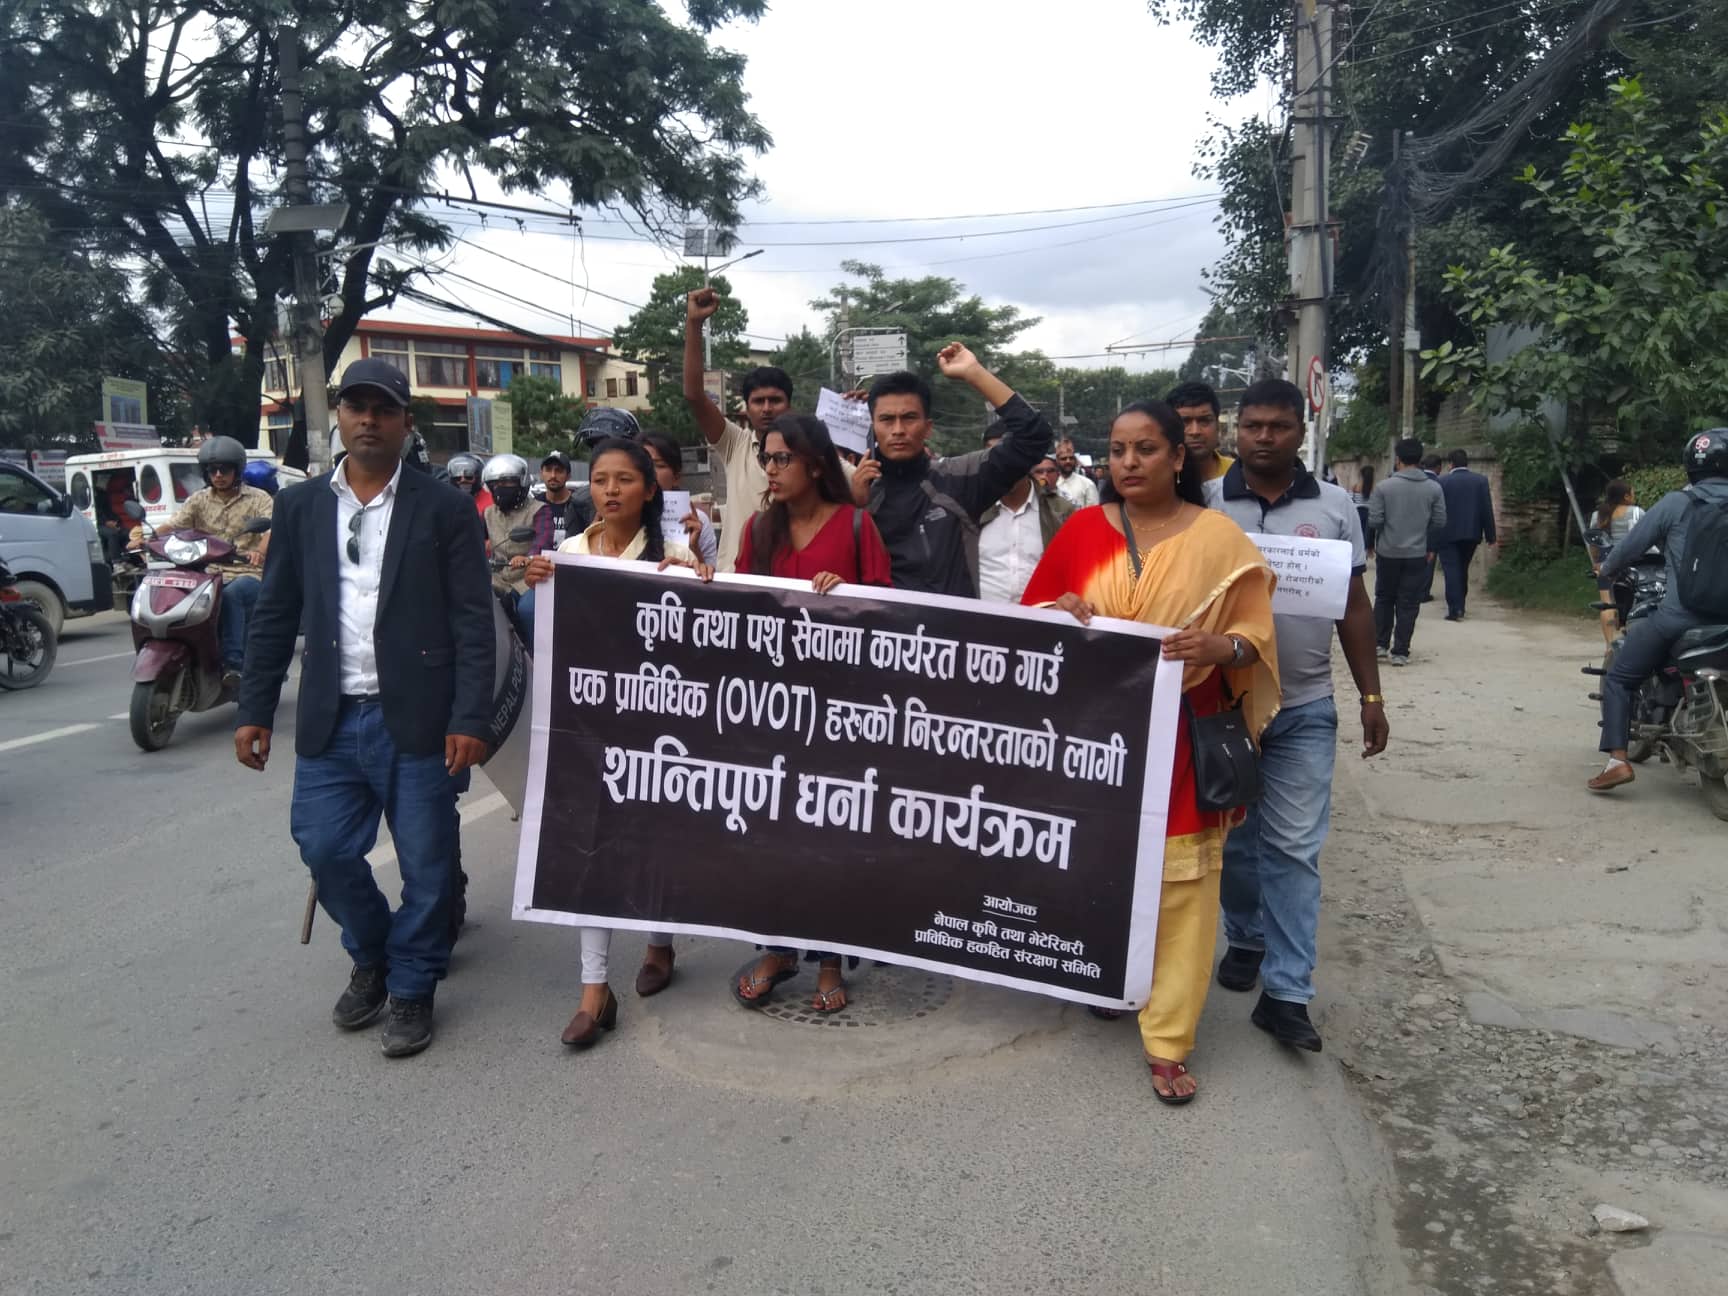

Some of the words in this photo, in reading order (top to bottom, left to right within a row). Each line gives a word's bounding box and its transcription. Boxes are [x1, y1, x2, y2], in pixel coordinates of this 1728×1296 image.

[636, 590, 687, 652] कृषि
[692, 607, 741, 650] तथा
[746, 614, 786, 668] पशु
[791, 608, 865, 666] सेवामा
[869, 623, 960, 681] कार्यरत
[965, 642, 1010, 685] एक
[1014, 641, 1065, 695] गाउँ
[489, 690, 519, 737] NEPAL
[568, 666, 609, 706] एक
[614, 661, 710, 718] प्राविधिक
[716, 675, 817, 747] (OVOT)
[824, 693, 898, 746] हरुको
[903, 696, 1059, 772] निरन्तरताको
[1062, 732, 1129, 787] लागी
[602, 734, 787, 835] शान्तिपूर्ण
[795, 767, 879, 834] धर्ना
[888, 784, 1077, 871] कार्यक्रम
[983, 895, 1038, 917] आयोजक
[914, 929, 964, 950] प्राविधिक
[966, 940, 1011, 960] हकहित
[1013, 949, 1059, 969] संरक्षण
[1061, 959, 1101, 979] समिति
[933, 910, 970, 932] नेपाल
[971, 920, 998, 938] कृषि
[1000, 927, 1026, 943] तथा
[1028, 930, 1085, 956] भेटेरिनरी
